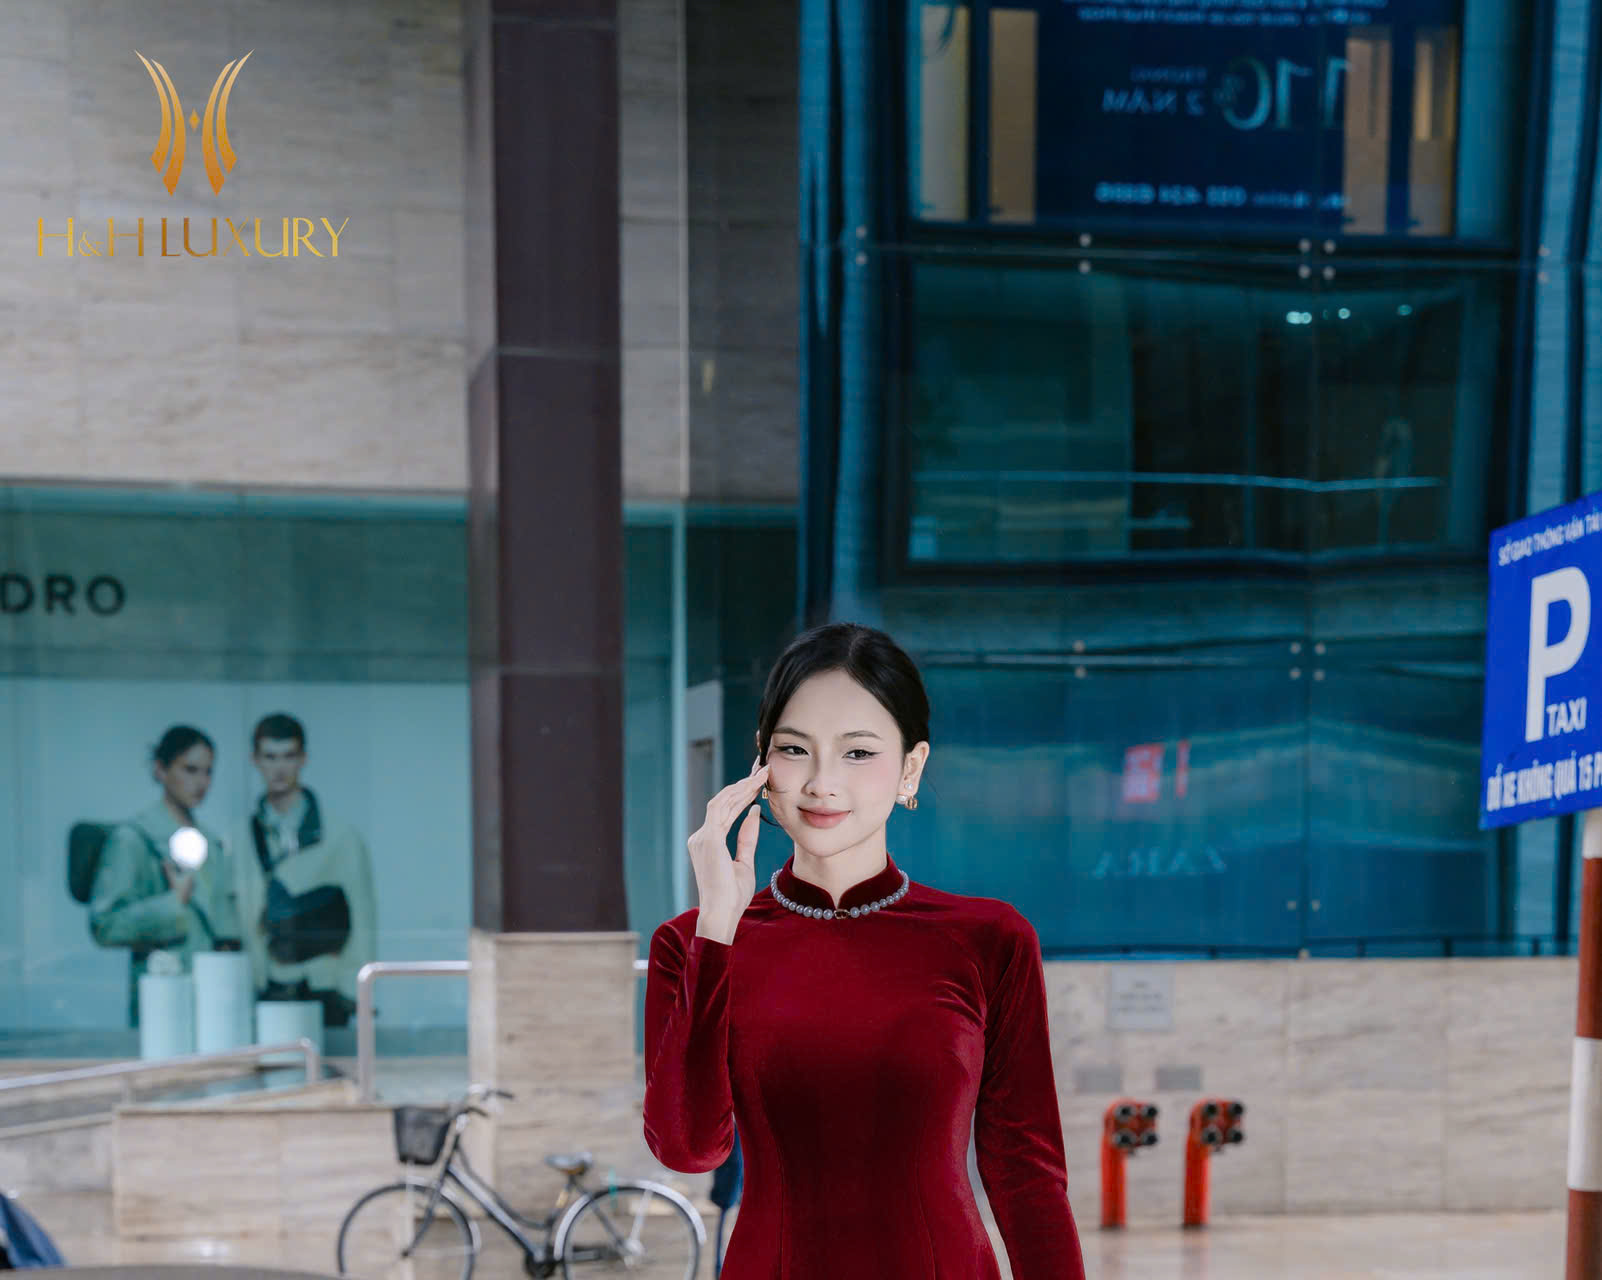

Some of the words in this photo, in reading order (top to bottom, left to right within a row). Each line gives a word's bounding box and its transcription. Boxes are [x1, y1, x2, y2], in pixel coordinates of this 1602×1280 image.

[0, 573, 126, 616] DRO
[1525, 566, 1591, 743] P
[1546, 696, 1587, 737] TAXI
[1517, 759, 1554, 805] KHÔNG
[1578, 753, 1593, 792] 15
